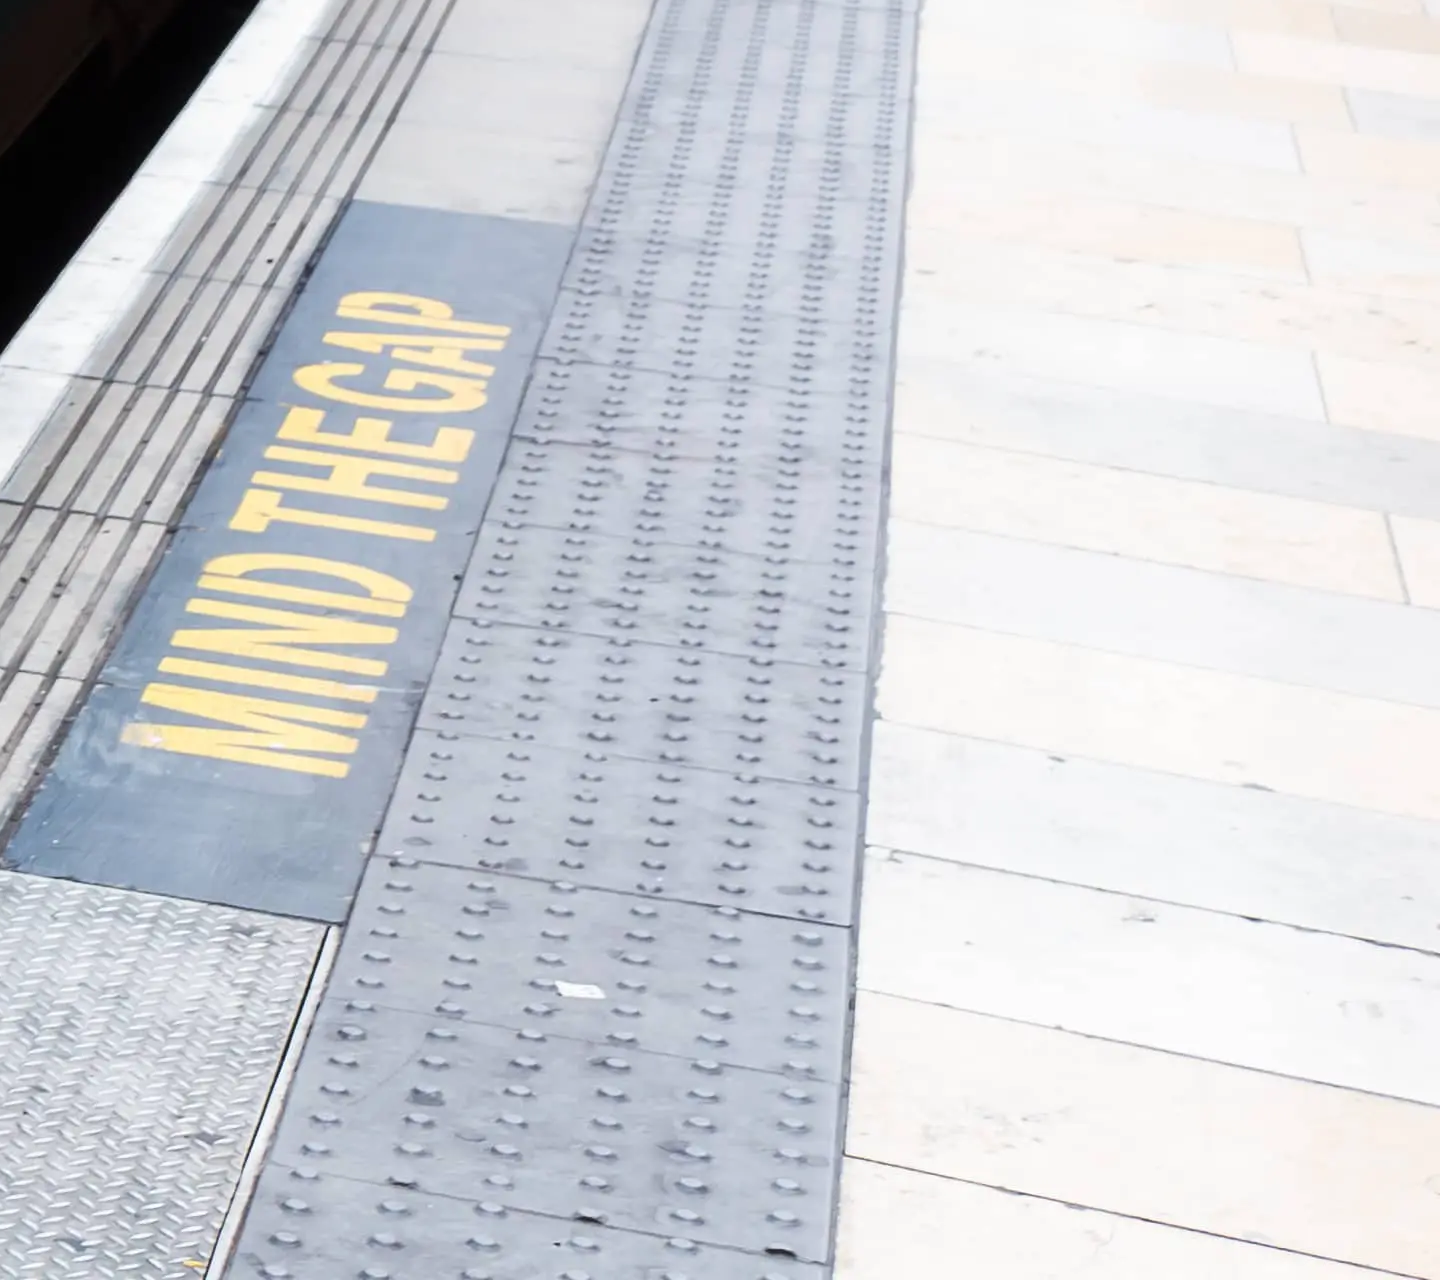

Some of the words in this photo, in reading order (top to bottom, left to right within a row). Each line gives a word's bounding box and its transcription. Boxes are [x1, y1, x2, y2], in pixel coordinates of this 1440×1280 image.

[292, 289, 513, 415] GAP
[227, 406, 476, 543] THE
[120, 552, 415, 779] MIND
